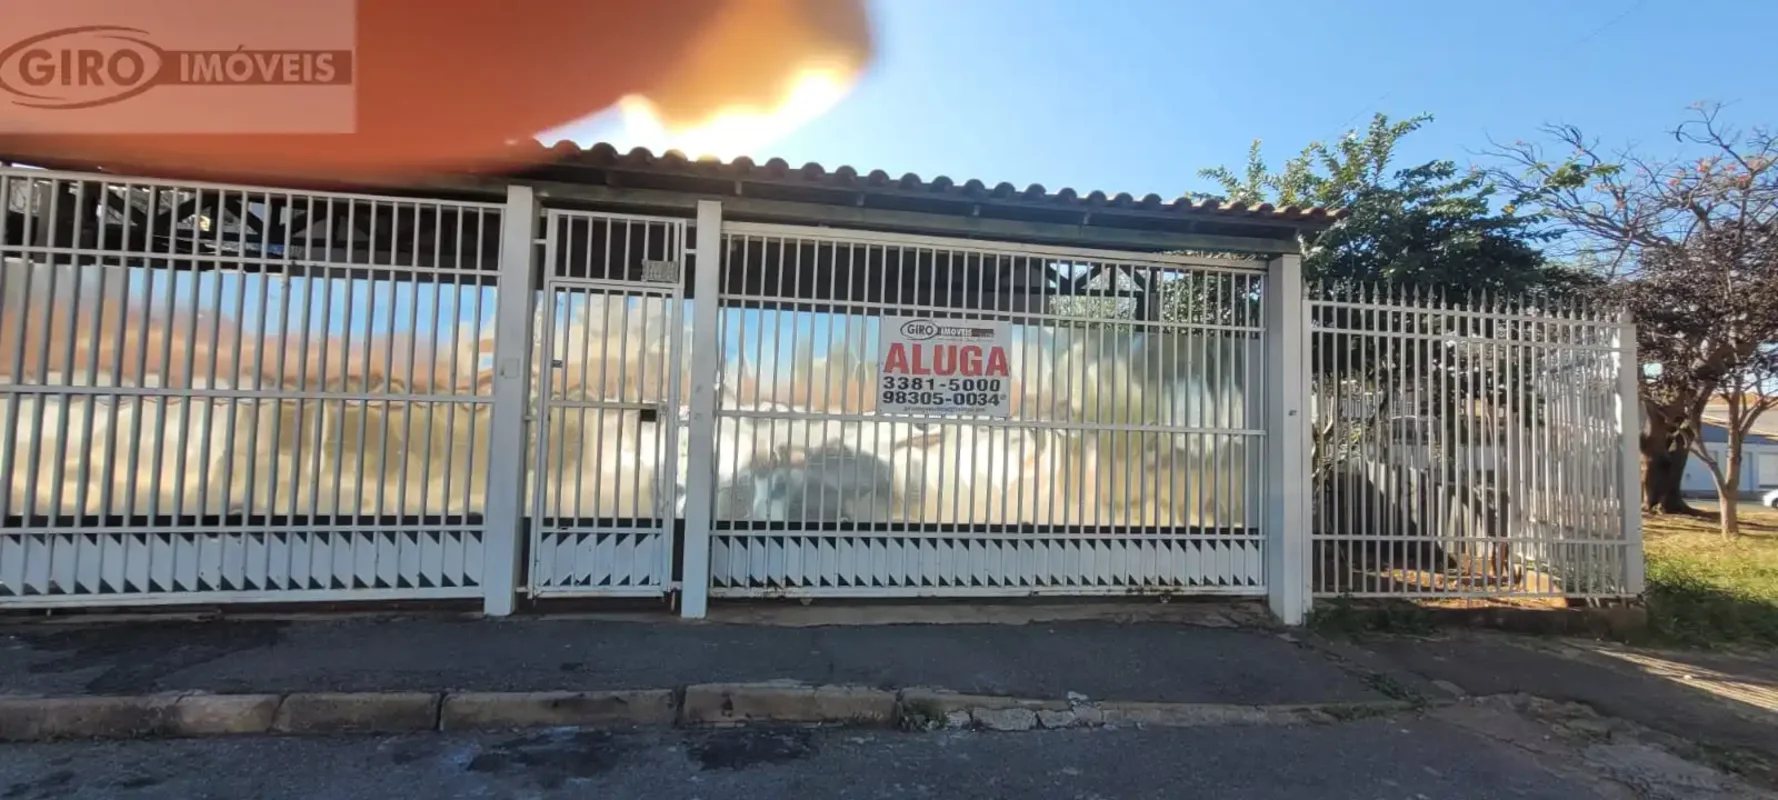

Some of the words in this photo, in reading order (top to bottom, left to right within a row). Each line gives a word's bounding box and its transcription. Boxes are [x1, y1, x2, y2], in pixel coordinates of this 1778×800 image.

[907, 324, 934, 336] GIRO
[882, 342, 1010, 377] ALUGA
[883, 376, 1001, 392] 3381-5000
[882, 391, 1001, 406] 98305-0034
